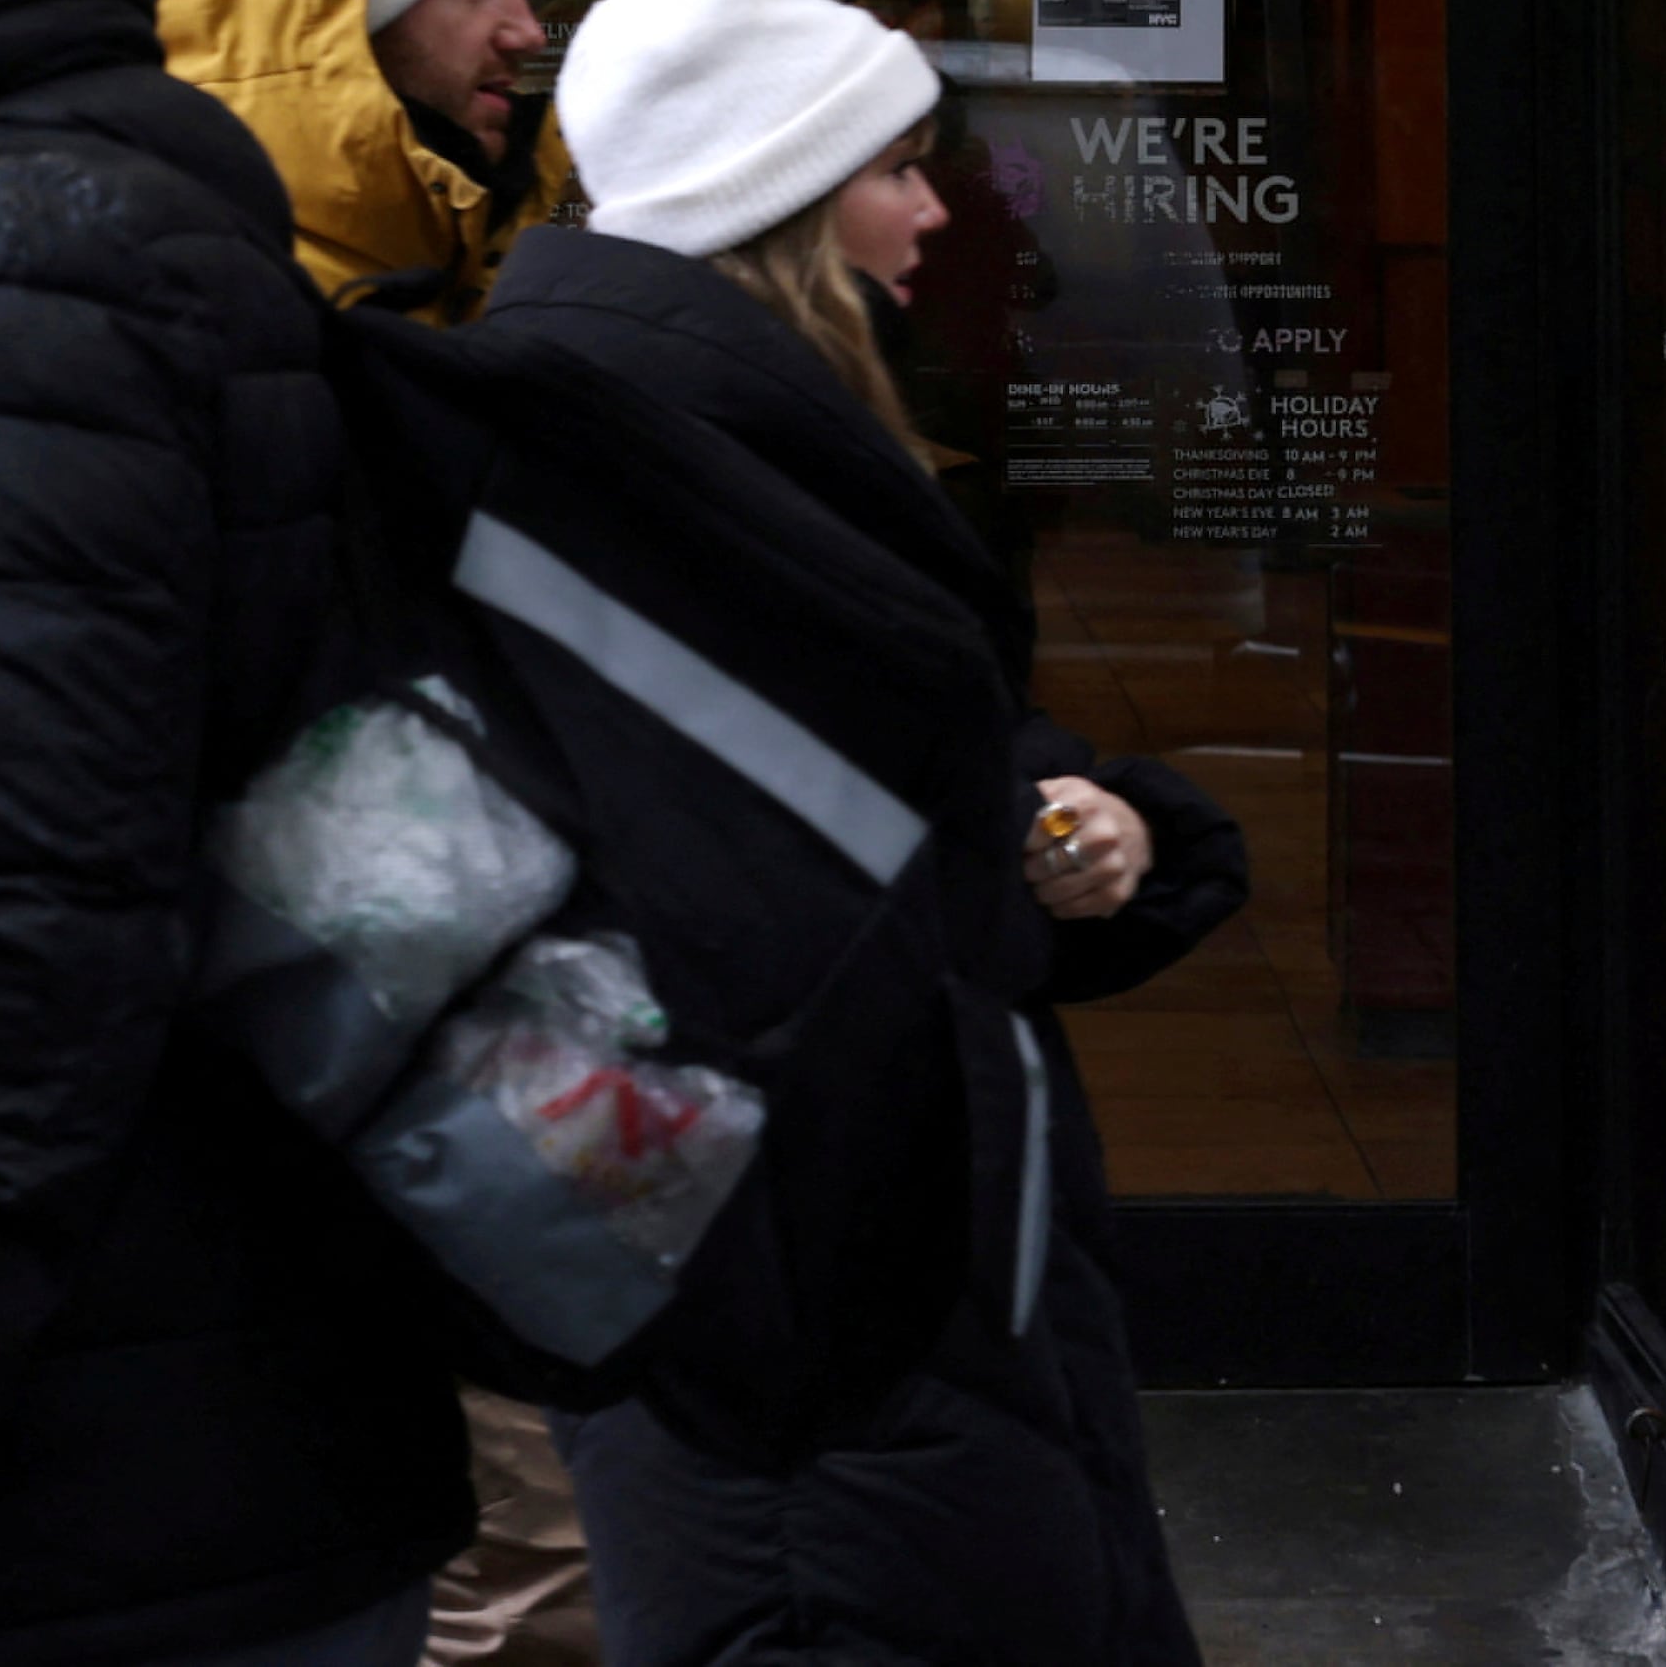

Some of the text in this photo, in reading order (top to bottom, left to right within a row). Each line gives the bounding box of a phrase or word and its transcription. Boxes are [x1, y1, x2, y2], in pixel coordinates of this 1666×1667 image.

[1070, 117, 1268, 165] WE'RE
[1073, 175, 1300, 225] HIRING
[1252, 328, 1349, 353] APPLY
[1270, 396, 1379, 415] HOLIDAY
[1280, 418, 1370, 439] HOURS
[1173, 447, 1270, 462] THANKSGIVING
[1354, 447, 1377, 462] PM
[1173, 468, 1245, 481] CHRISTMAS
[1247, 468, 1270, 481] EVE
[1173, 483, 1335, 500] CHRISTMAS DAY CLOSED
[1173, 506, 1204, 519] NEW
[1173, 525, 1204, 539] NEW
[1250, 525, 1278, 539] DAY
[1343, 525, 1369, 539] AM
